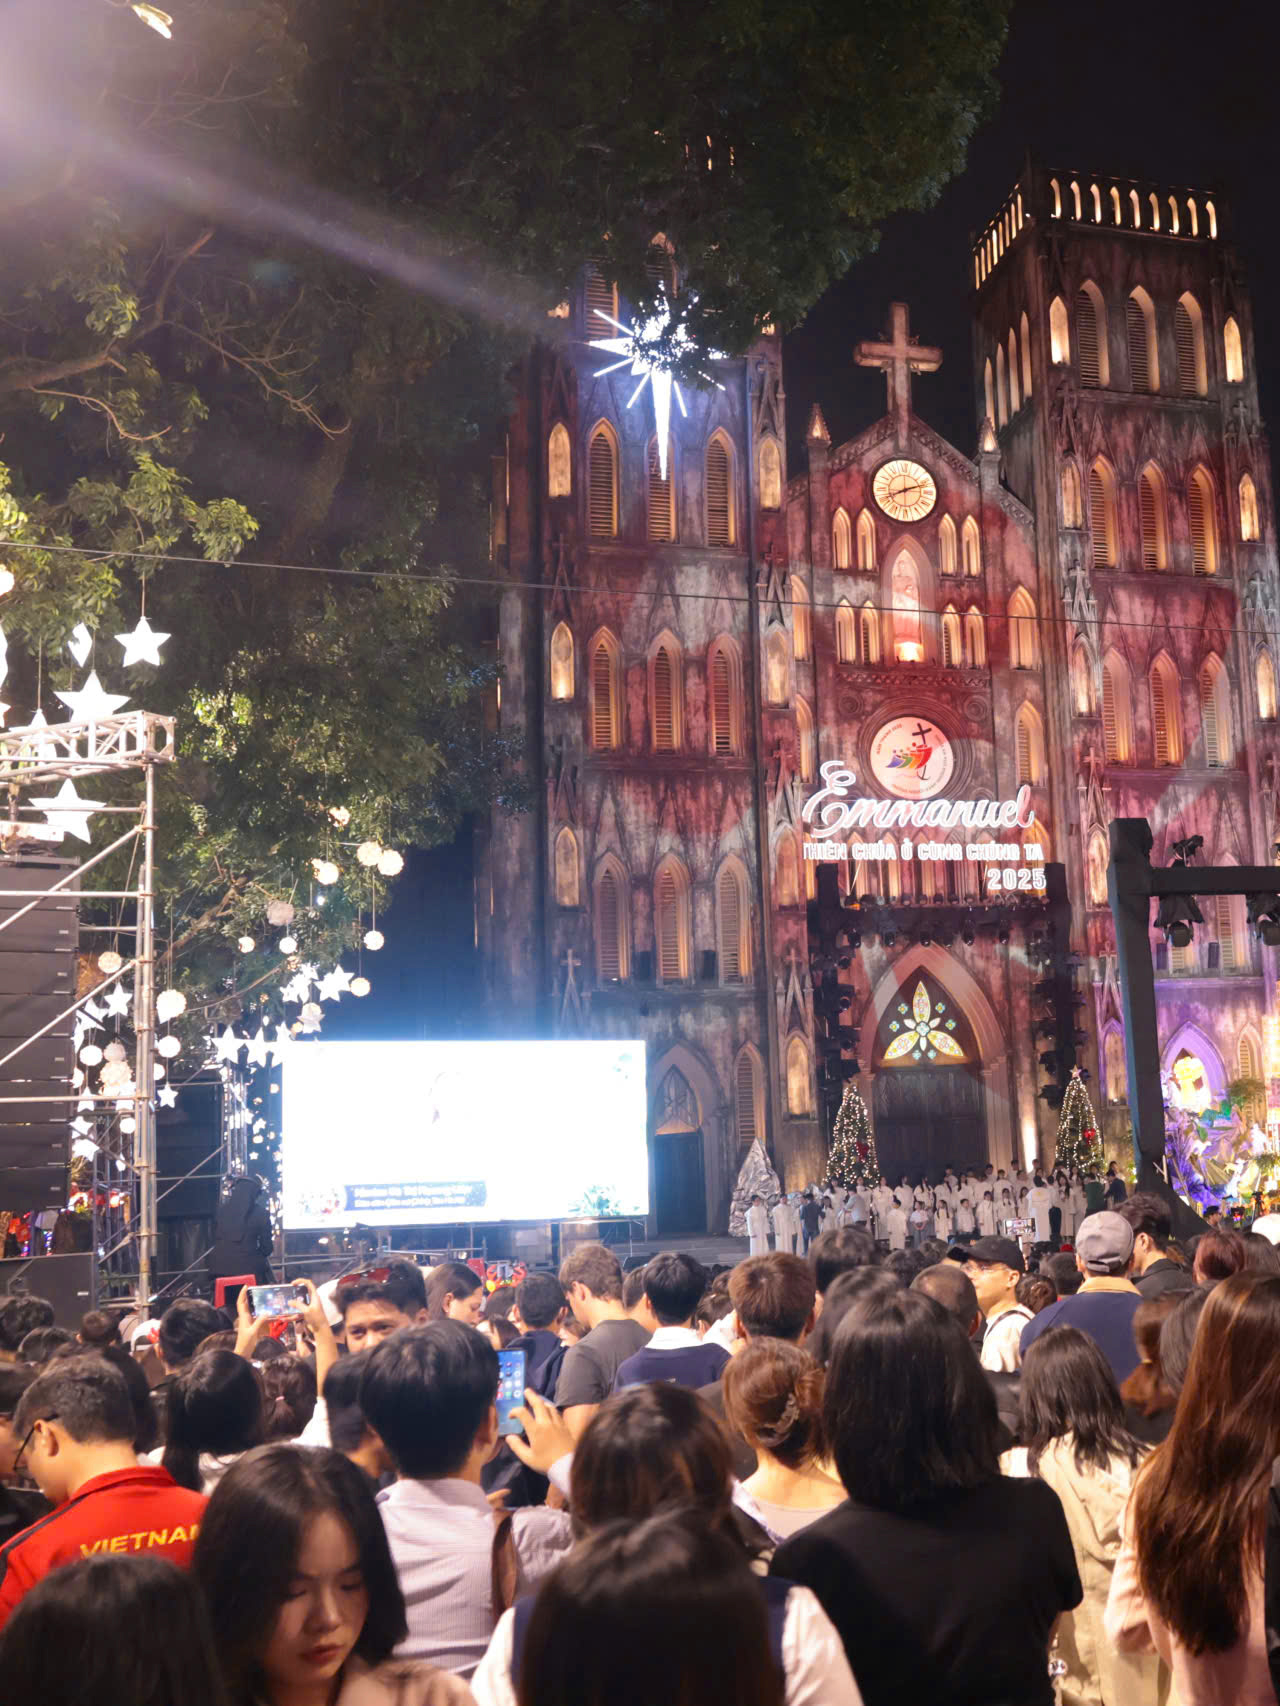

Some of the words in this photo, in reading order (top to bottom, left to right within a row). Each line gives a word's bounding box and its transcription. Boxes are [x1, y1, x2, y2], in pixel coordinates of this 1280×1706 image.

[802, 760, 1035, 838] Emmanuel
[803, 839, 848, 860] THIÊN
[851, 839, 897, 860] CHÚA
[1023, 843, 1045, 860] TA
[987, 867, 1047, 890] 2025
[80, 1523, 199, 1559] VIETNA
